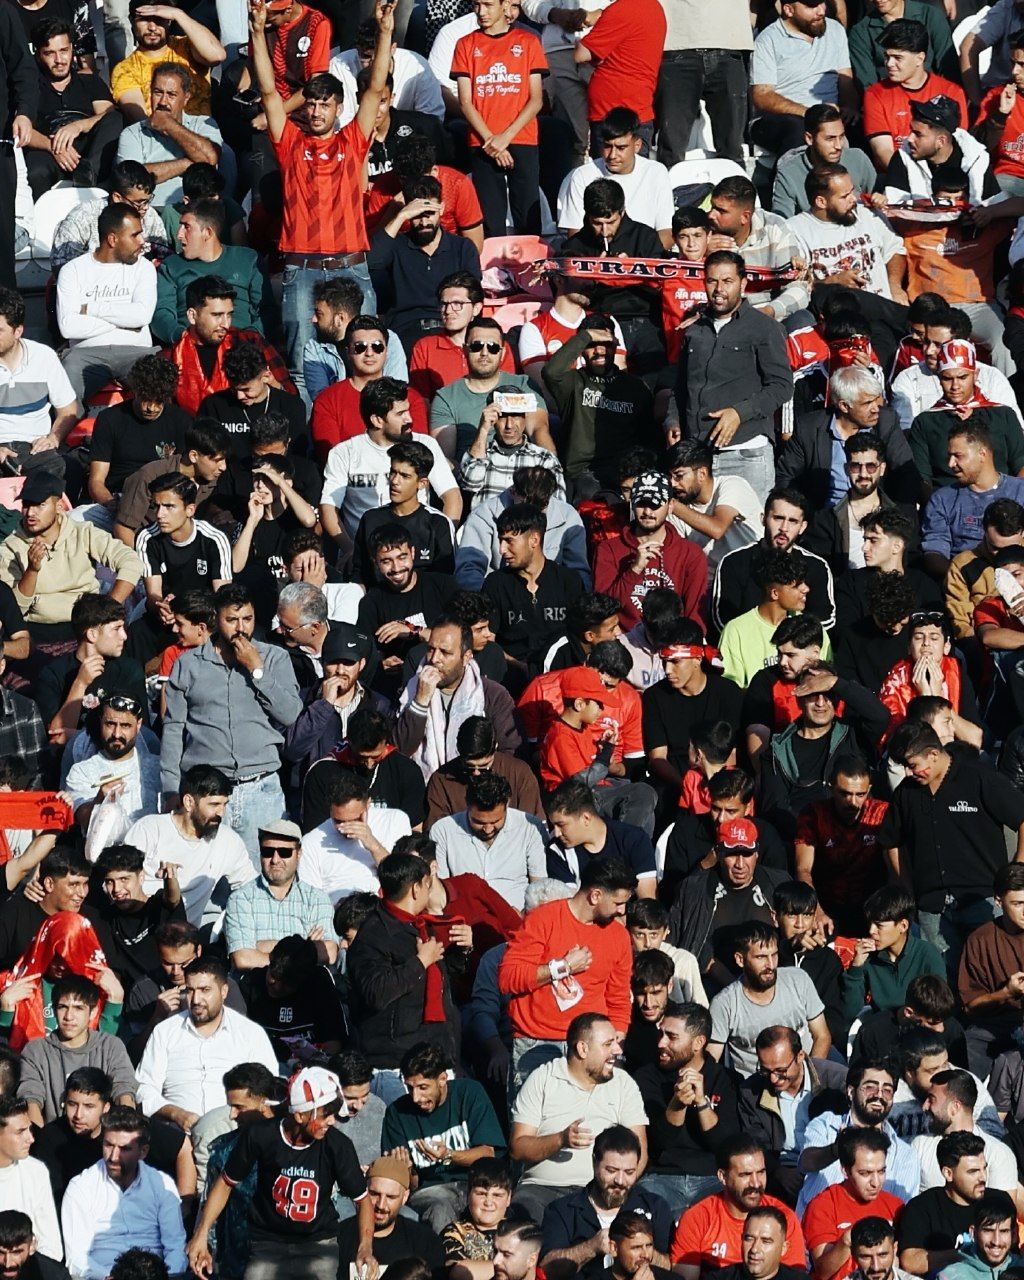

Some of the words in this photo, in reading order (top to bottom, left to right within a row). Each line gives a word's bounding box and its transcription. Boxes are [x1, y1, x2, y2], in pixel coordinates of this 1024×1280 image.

[475, 73, 522, 85] AIRLINES
[85, 284, 130, 301] Adidas
[280, 1166, 315, 1179] adidas
[272, 1175, 319, 1223] 49
[711, 1242, 727, 1259] 34
